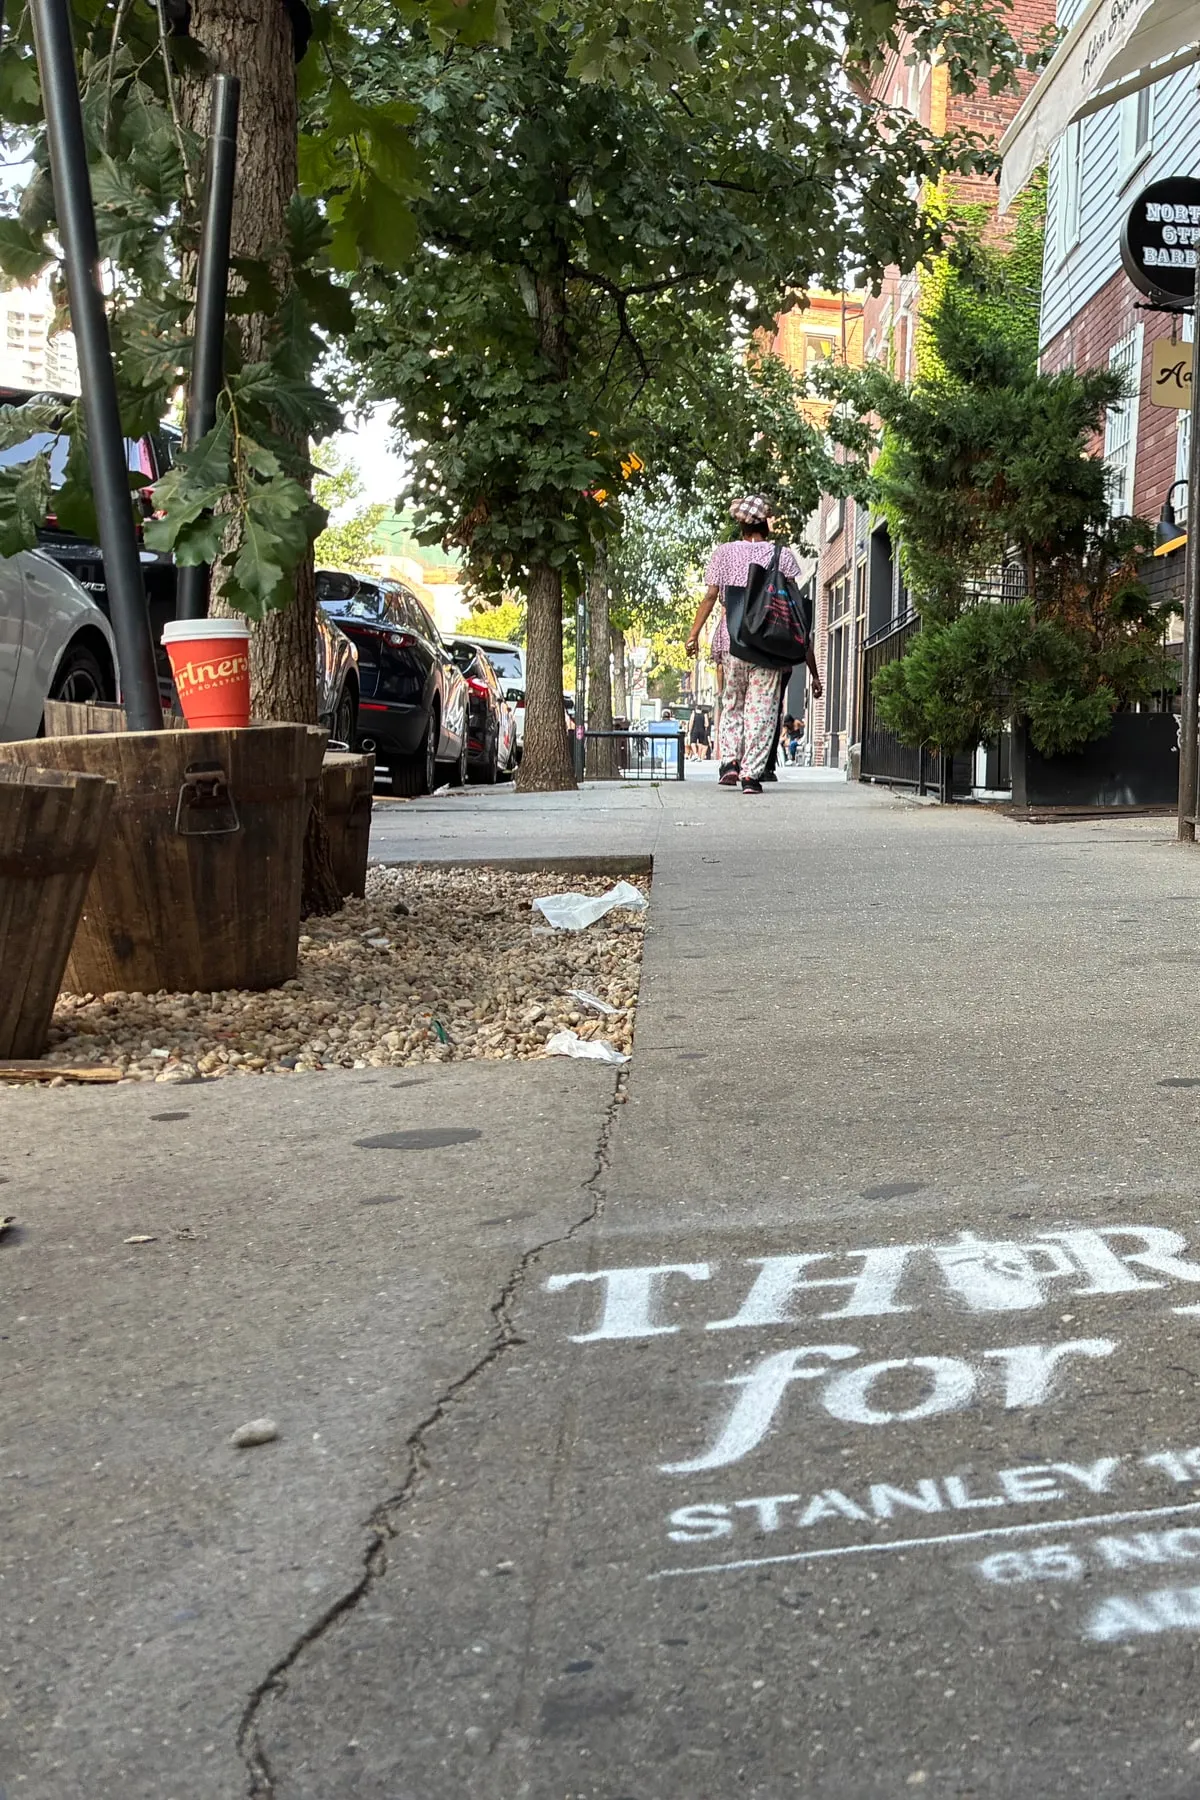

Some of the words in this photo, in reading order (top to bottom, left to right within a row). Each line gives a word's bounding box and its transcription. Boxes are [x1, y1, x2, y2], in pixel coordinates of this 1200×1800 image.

[659, 1338, 1115, 1473] for
[667, 1457, 1120, 1543] STANLEY
[978, 1543, 1084, 1585] 65
